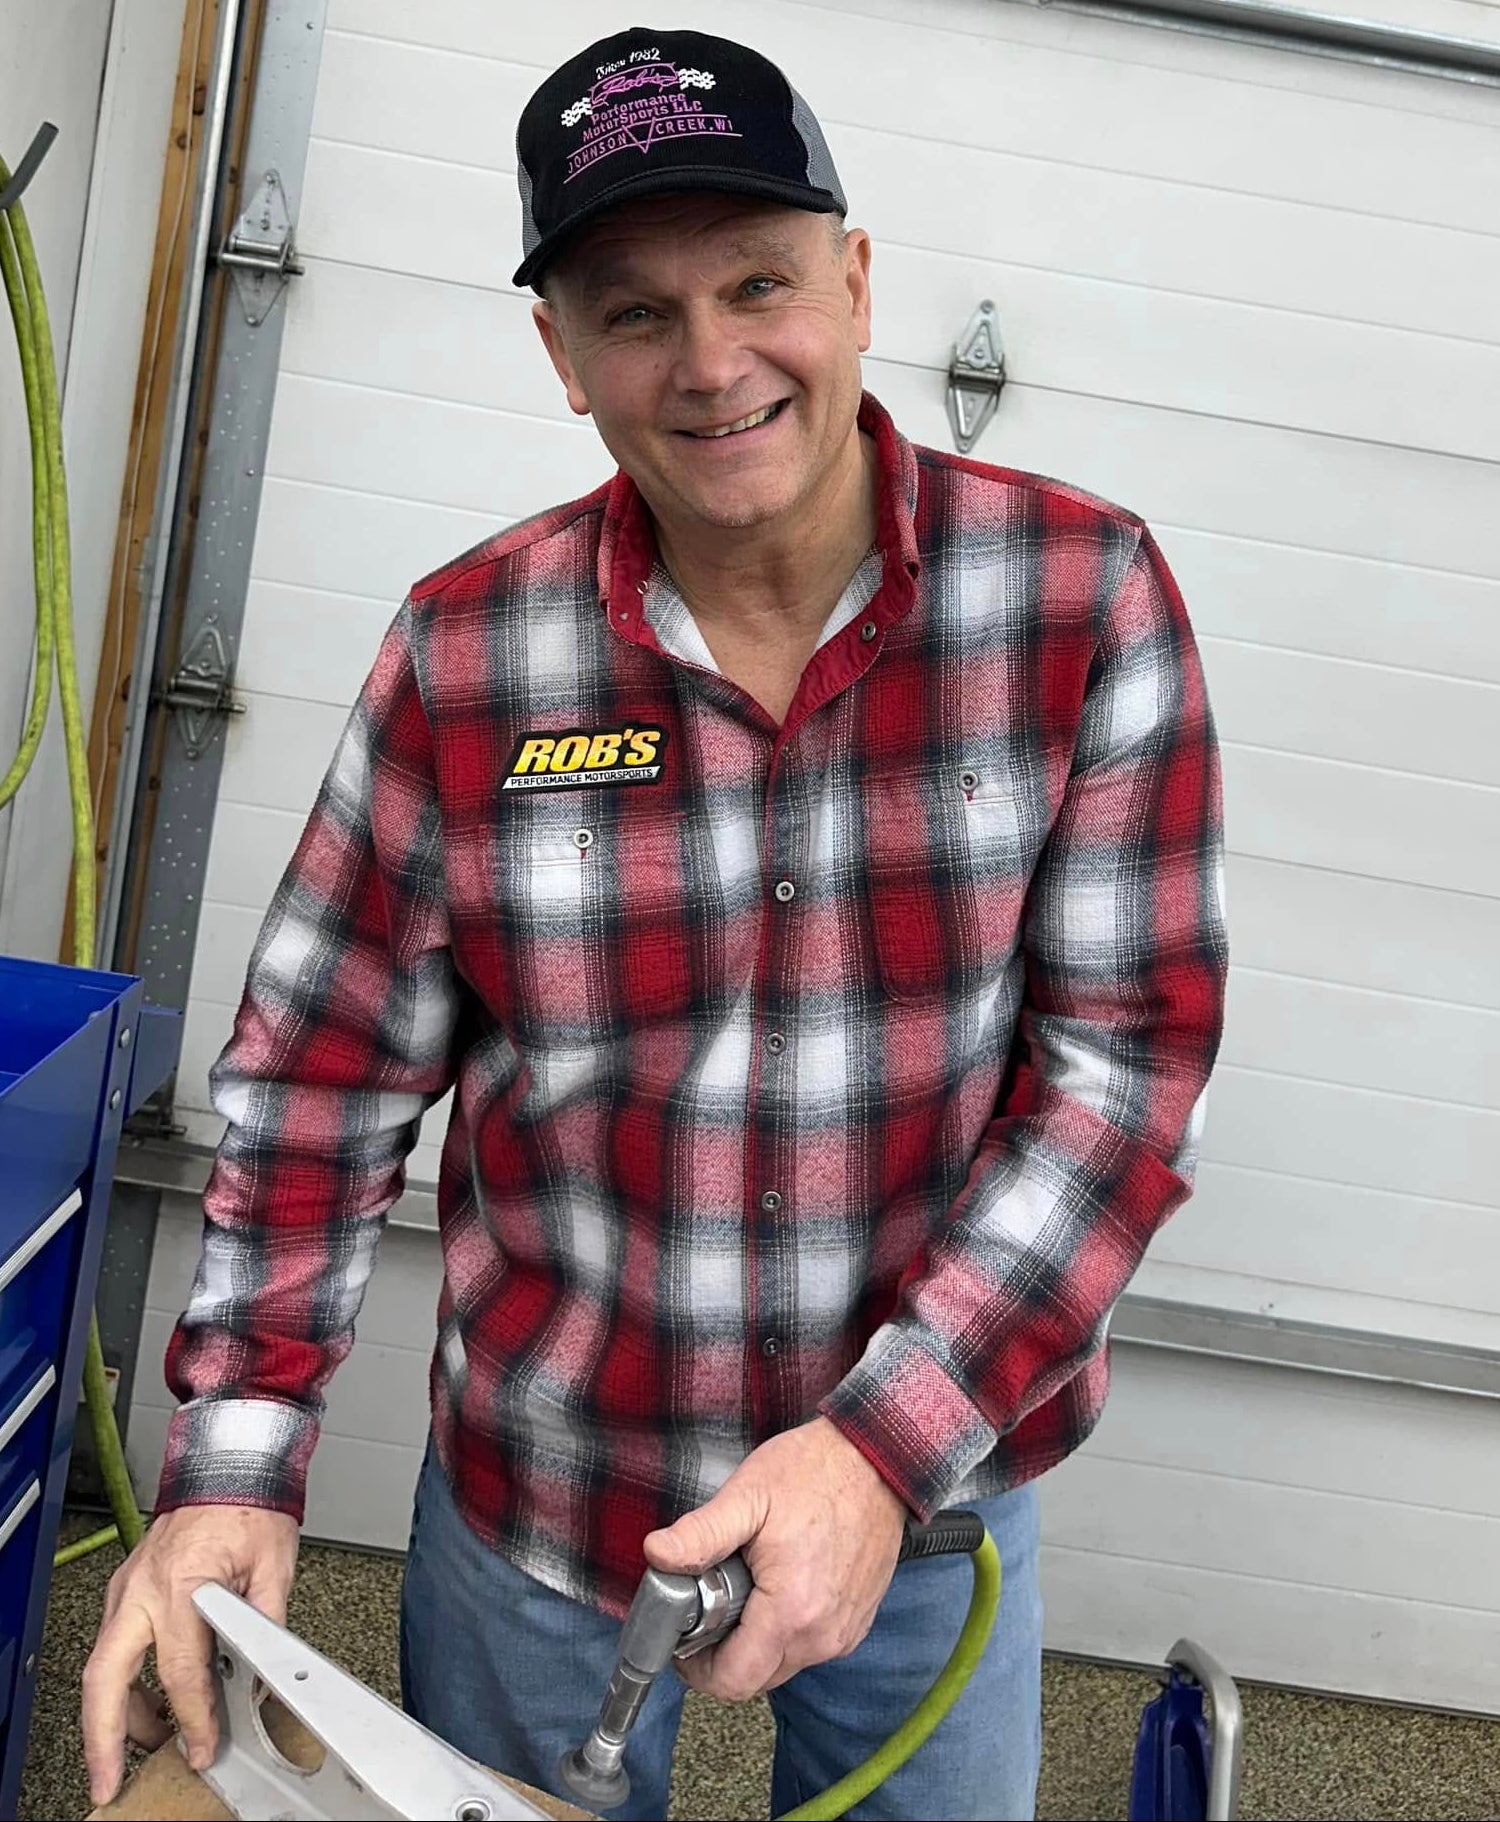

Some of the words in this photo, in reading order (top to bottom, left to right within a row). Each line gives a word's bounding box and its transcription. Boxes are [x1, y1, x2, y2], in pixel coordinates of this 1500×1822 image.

[629, 47, 661, 63] 1982
[583, 106, 669, 143] MotorSports
[672, 100, 703, 113] LLC
[591, 93, 686, 126] Performance
[567, 132, 627, 174] JOHNSON
[513, 729, 661, 774] ROB'S
[511, 774, 582, 787] PERFORMANCE
[584, 768, 653, 782] MOTORSPORTS
